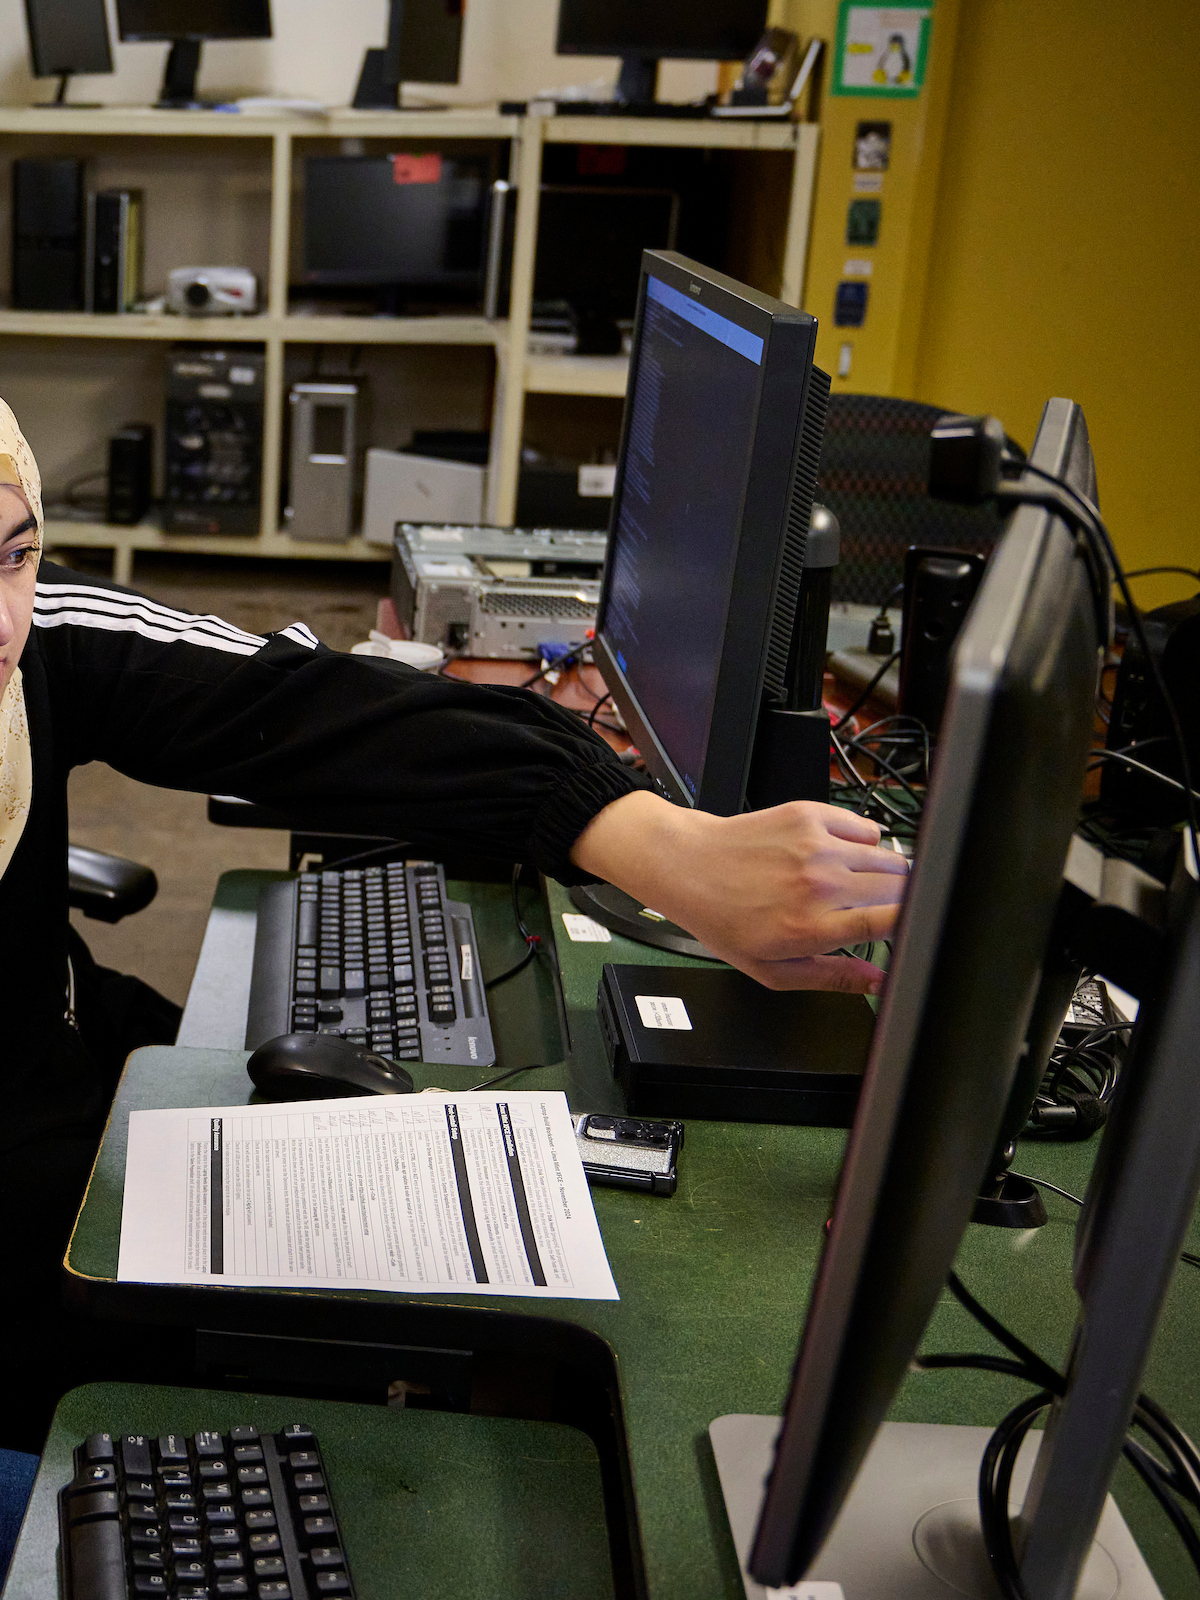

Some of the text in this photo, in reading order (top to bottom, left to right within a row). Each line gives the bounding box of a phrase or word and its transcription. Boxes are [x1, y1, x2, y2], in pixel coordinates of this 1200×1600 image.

[467, 1036, 478, 1060] lenovo
[539, 1102, 547, 1115] Laptop
[446, 1105, 459, 1139] Post-Install Setup
[542, 1116, 550, 1125] Build
[498, 1103, 516, 1156] Linux Mint XFCE Installation
[544, 1127, 555, 1147] Worksheet
[550, 1150, 558, 1161] Linux
[553, 1162, 561, 1171] Mint
[555, 1172, 563, 1182] XFCE
[558, 1187, 569, 1207] November
[563, 1208, 571, 1219] 2024
[218, 1484, 228, 1493] W
[184, 1516, 194, 1524] D
[146, 1528, 158, 1536] C
[224, 1528, 235, 1536] R
[150, 1553, 160, 1561] V
[234, 1577, 244, 1586] Y
